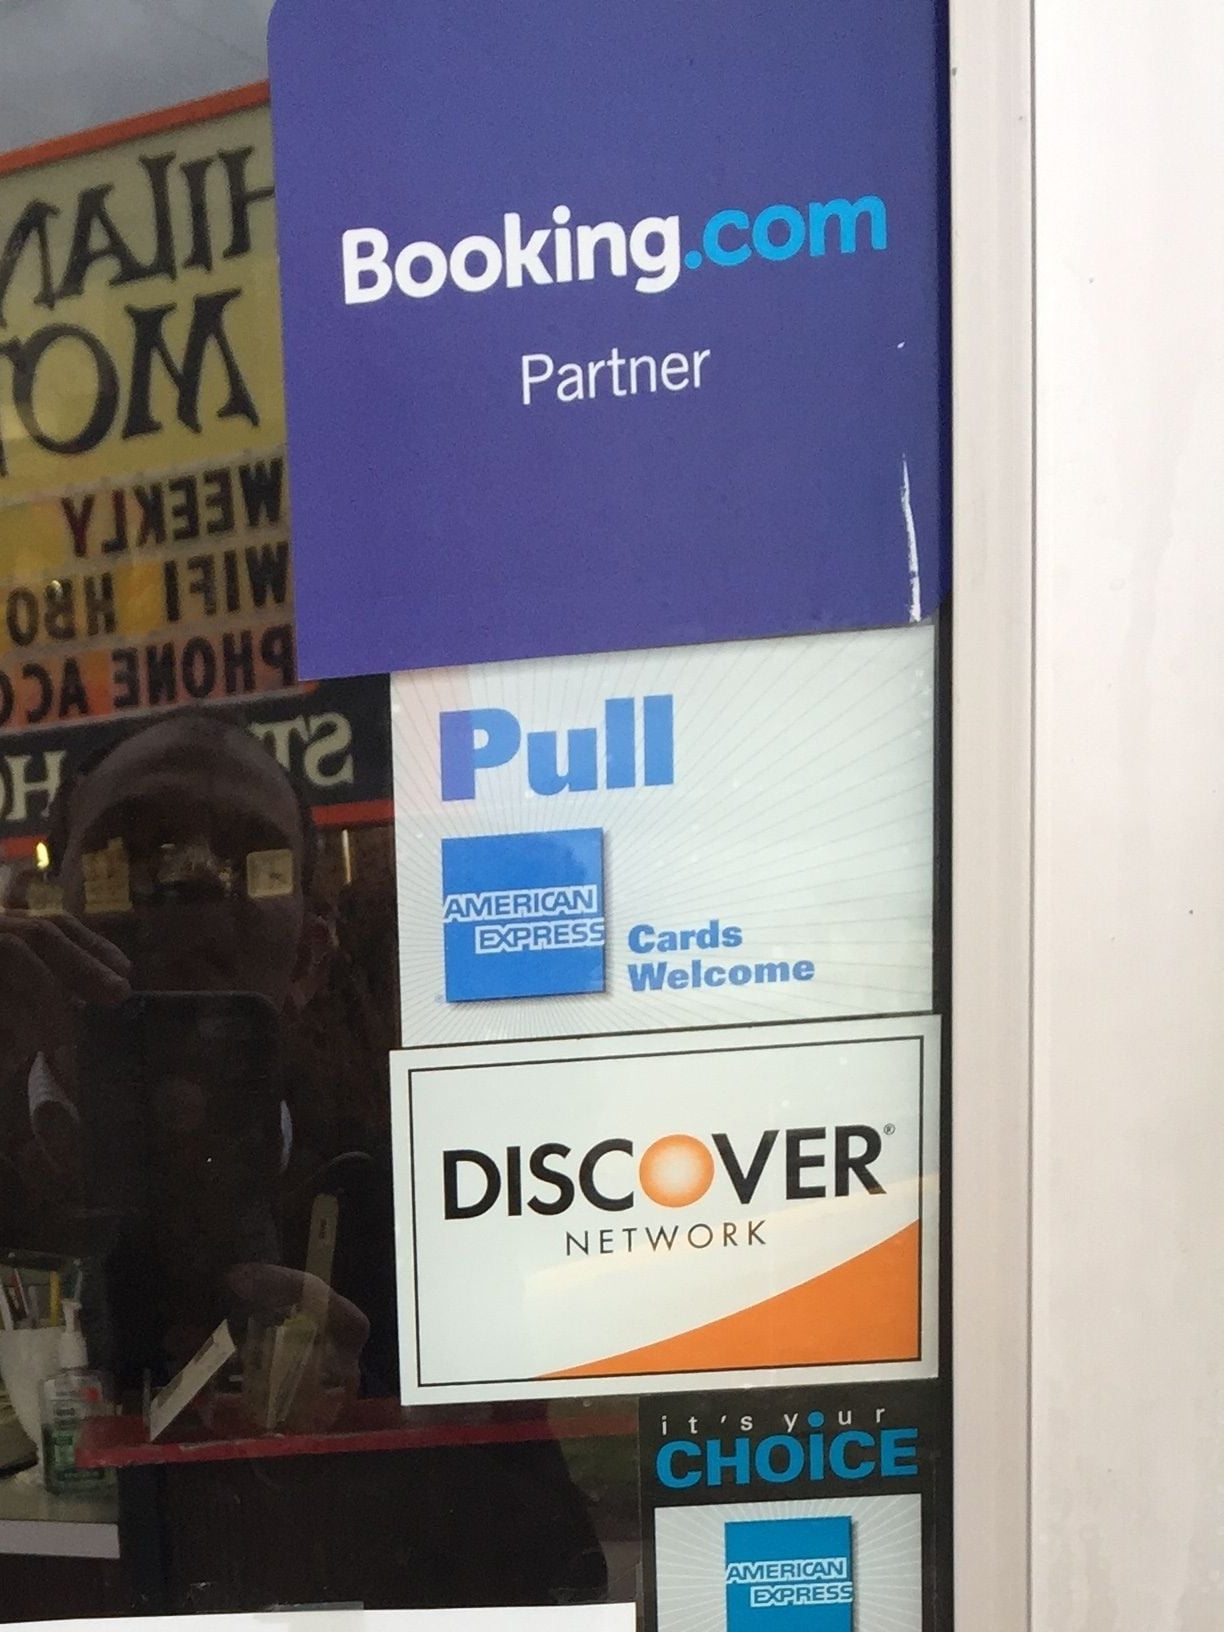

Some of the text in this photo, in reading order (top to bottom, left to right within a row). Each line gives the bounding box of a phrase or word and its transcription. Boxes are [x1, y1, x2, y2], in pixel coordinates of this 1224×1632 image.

[342, 194, 887, 305] Booking.com
[520, 347, 711, 405] Partner
[438, 694, 675, 802] Pull
[443, 884, 598, 922] AMERICAN
[475, 921, 606, 953] EXPRESS
[627, 920, 744, 956] Cards
[628, 955, 816, 994] Welcome
[442, 1123, 888, 1221] DISCOVER
[565, 1220, 768, 1257] NETWORK
[660, 1412, 754, 1437] it's
[725, 1558, 847, 1583] AMERICAN
[751, 1582, 853, 1607] EXPRESS
